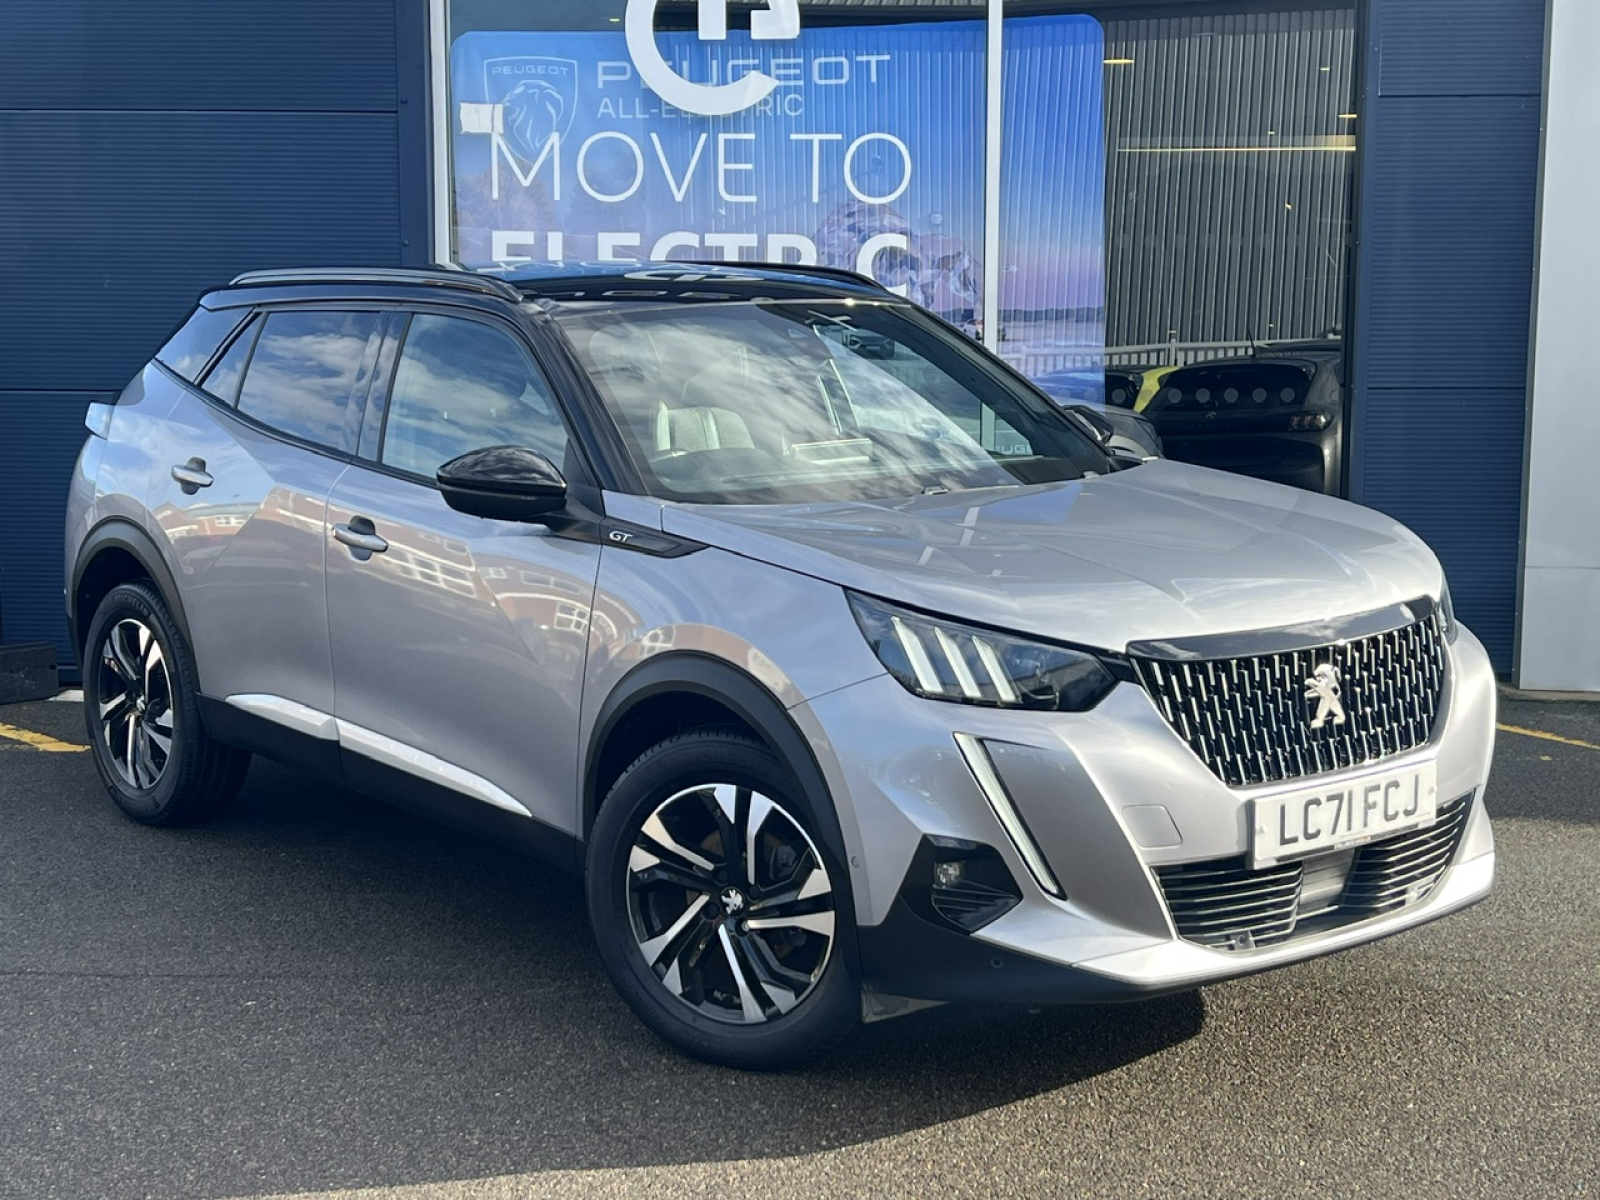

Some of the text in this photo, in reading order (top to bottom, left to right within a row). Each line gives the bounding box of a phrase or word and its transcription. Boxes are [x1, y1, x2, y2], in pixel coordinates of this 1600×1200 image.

[491, 65, 569, 76] PEUGEOT
[597, 54, 891, 89] PUGEOT
[597, 93, 803, 119] ALL-ERIC
[491, 131, 912, 204] MOVE TO
[609, 530, 634, 543] GT
[1279, 774, 1420, 846] LC71 FCJ
